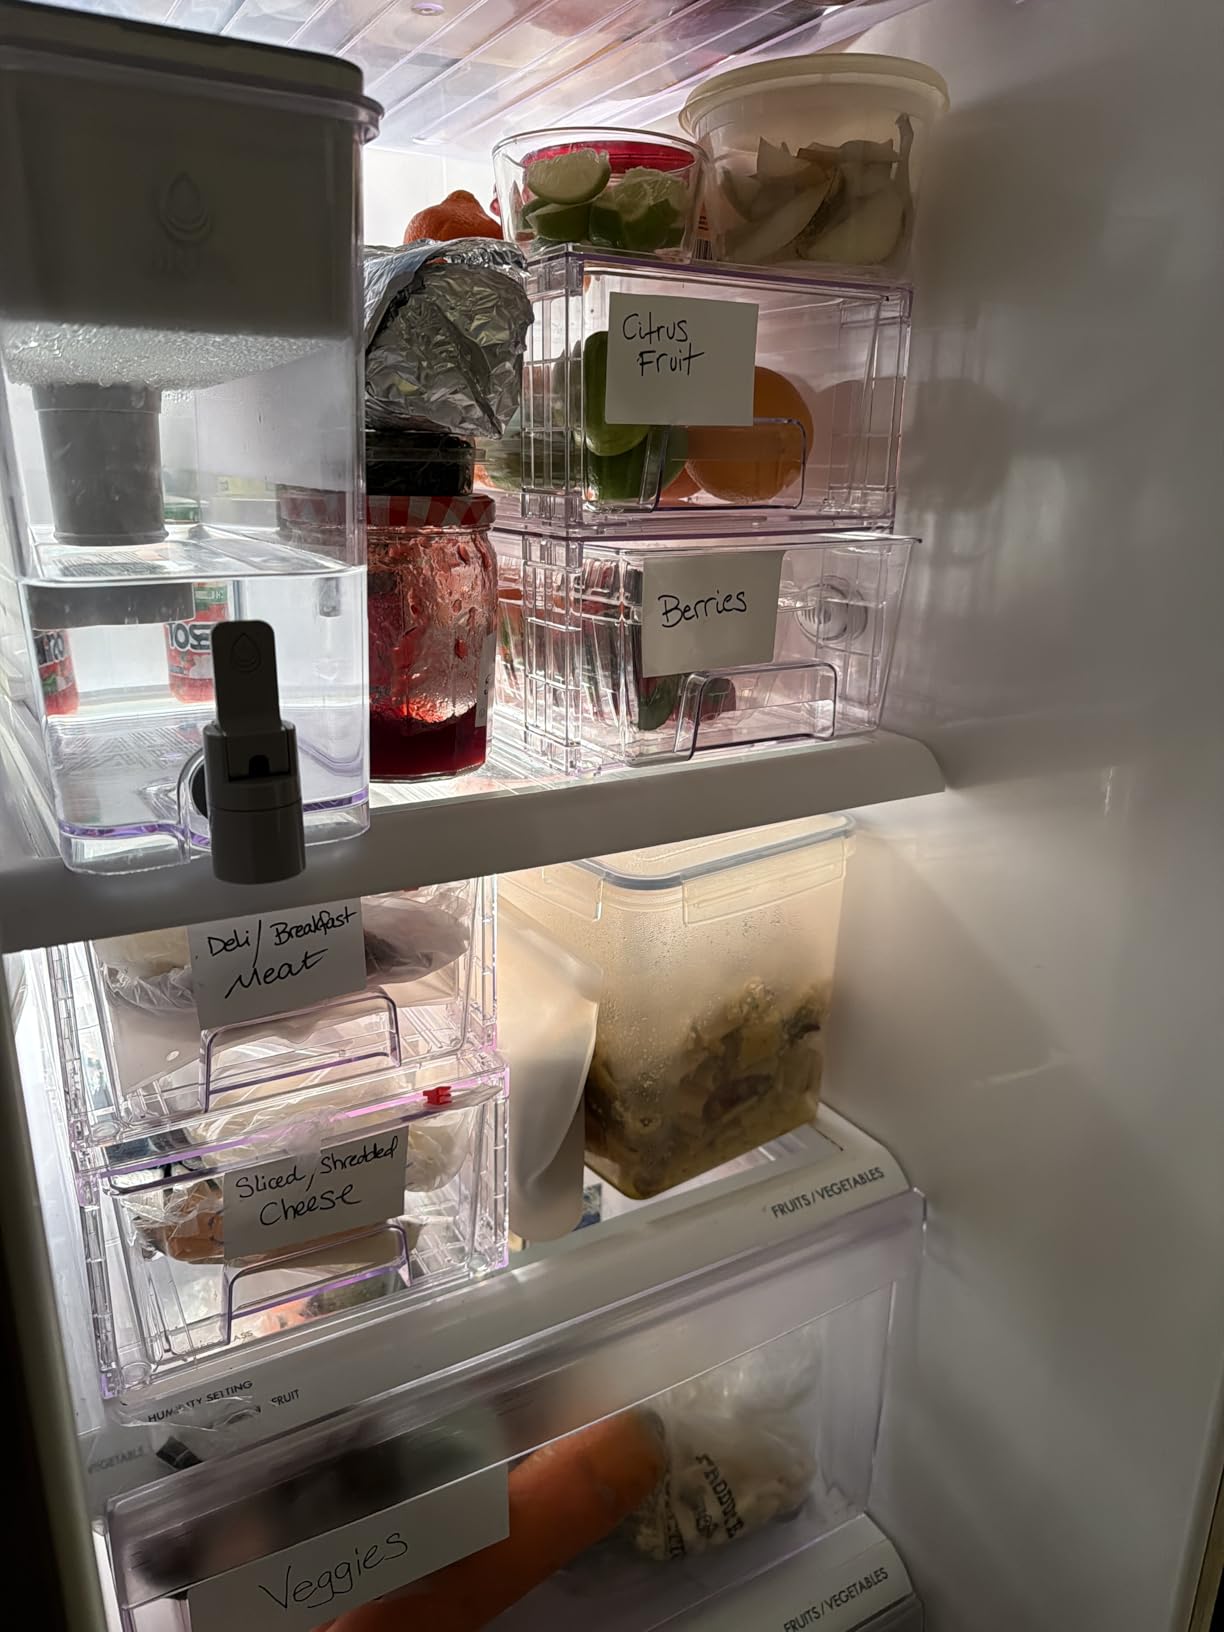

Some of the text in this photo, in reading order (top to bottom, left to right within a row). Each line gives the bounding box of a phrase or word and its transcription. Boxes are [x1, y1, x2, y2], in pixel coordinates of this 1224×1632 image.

[622, 311, 688, 345] Citrus
[636, 342, 705, 377] Fruit
[657, 589, 747, 628] Berries
[224, 948, 329, 999] Meat
[259, 1183, 362, 1226] Cheese
[258, 1532, 408, 1610] Veggies
